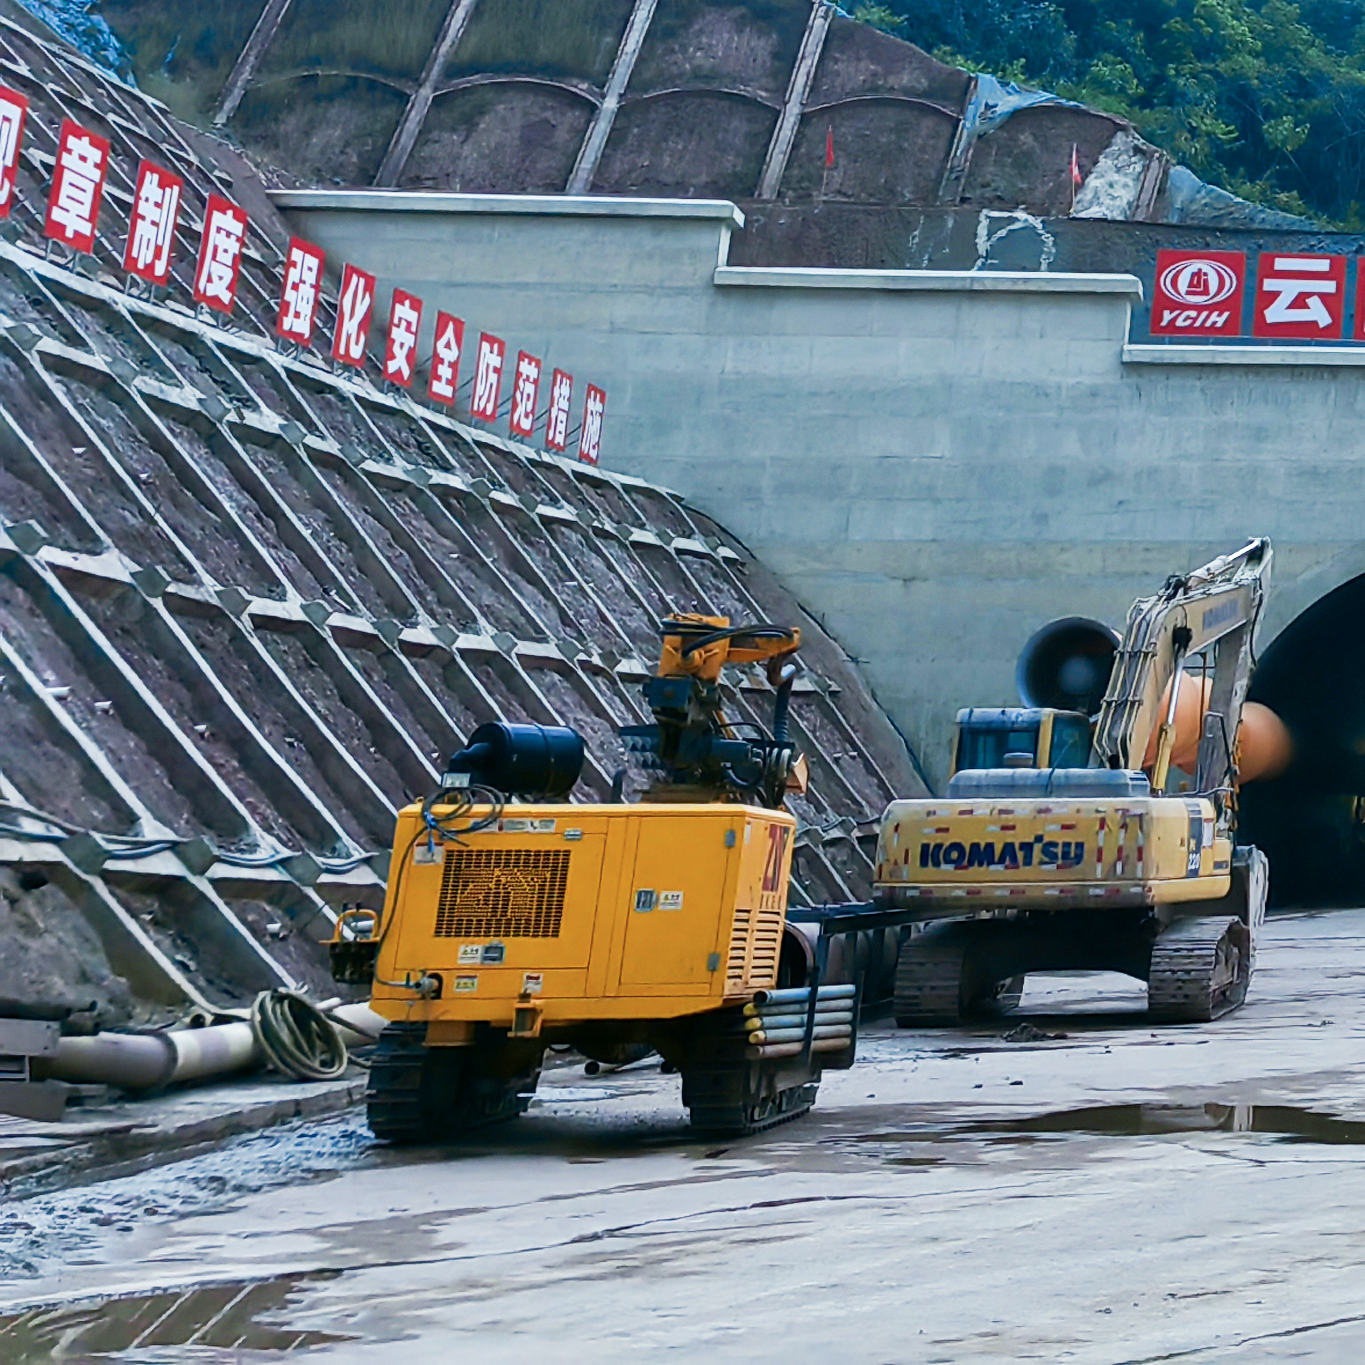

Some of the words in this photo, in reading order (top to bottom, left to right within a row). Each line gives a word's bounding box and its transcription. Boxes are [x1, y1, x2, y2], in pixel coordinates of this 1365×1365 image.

[1159, 309, 1231, 328] YCIH
[282, 246, 605, 462] 强化安全防范措施
[919, 833, 1086, 869] KOMATSU
